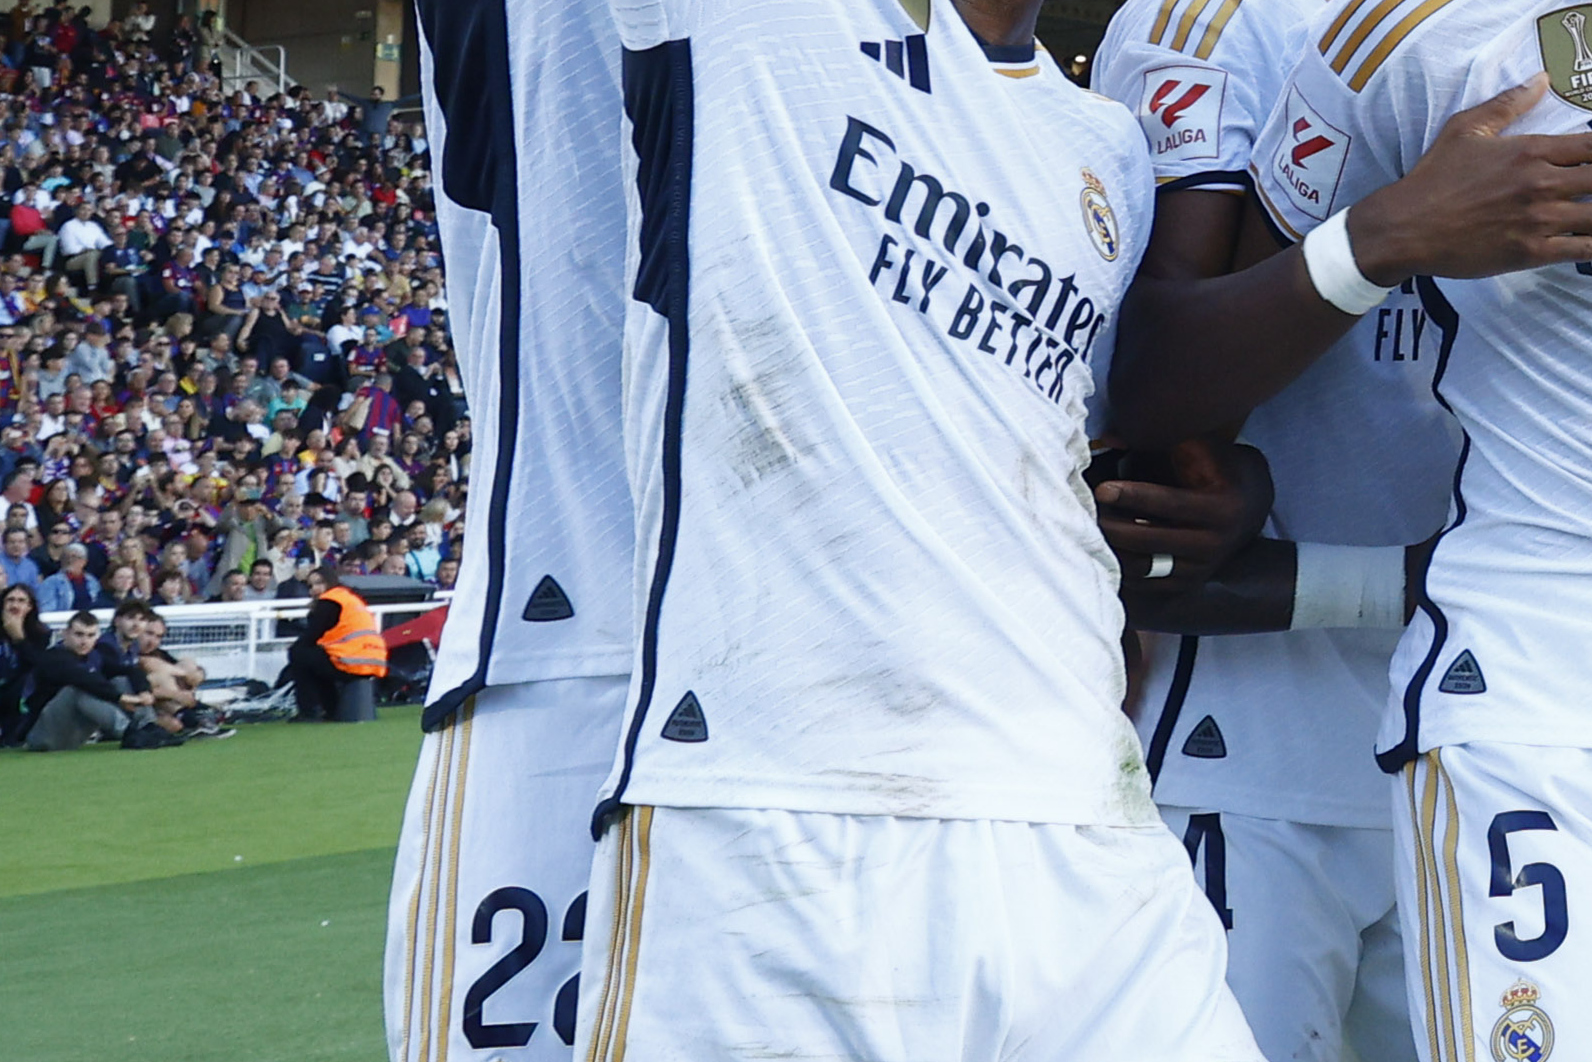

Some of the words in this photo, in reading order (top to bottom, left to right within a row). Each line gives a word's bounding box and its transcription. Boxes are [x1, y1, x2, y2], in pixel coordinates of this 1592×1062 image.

[1157, 129, 1207, 155] LALIGA
[1278, 153, 1320, 204] LALIGA
[869, 233, 949, 314] FLY
[947, 283, 1075, 404] BETTER
[1374, 309, 1426, 361] FLY
[1487, 810, 1569, 962] 5
